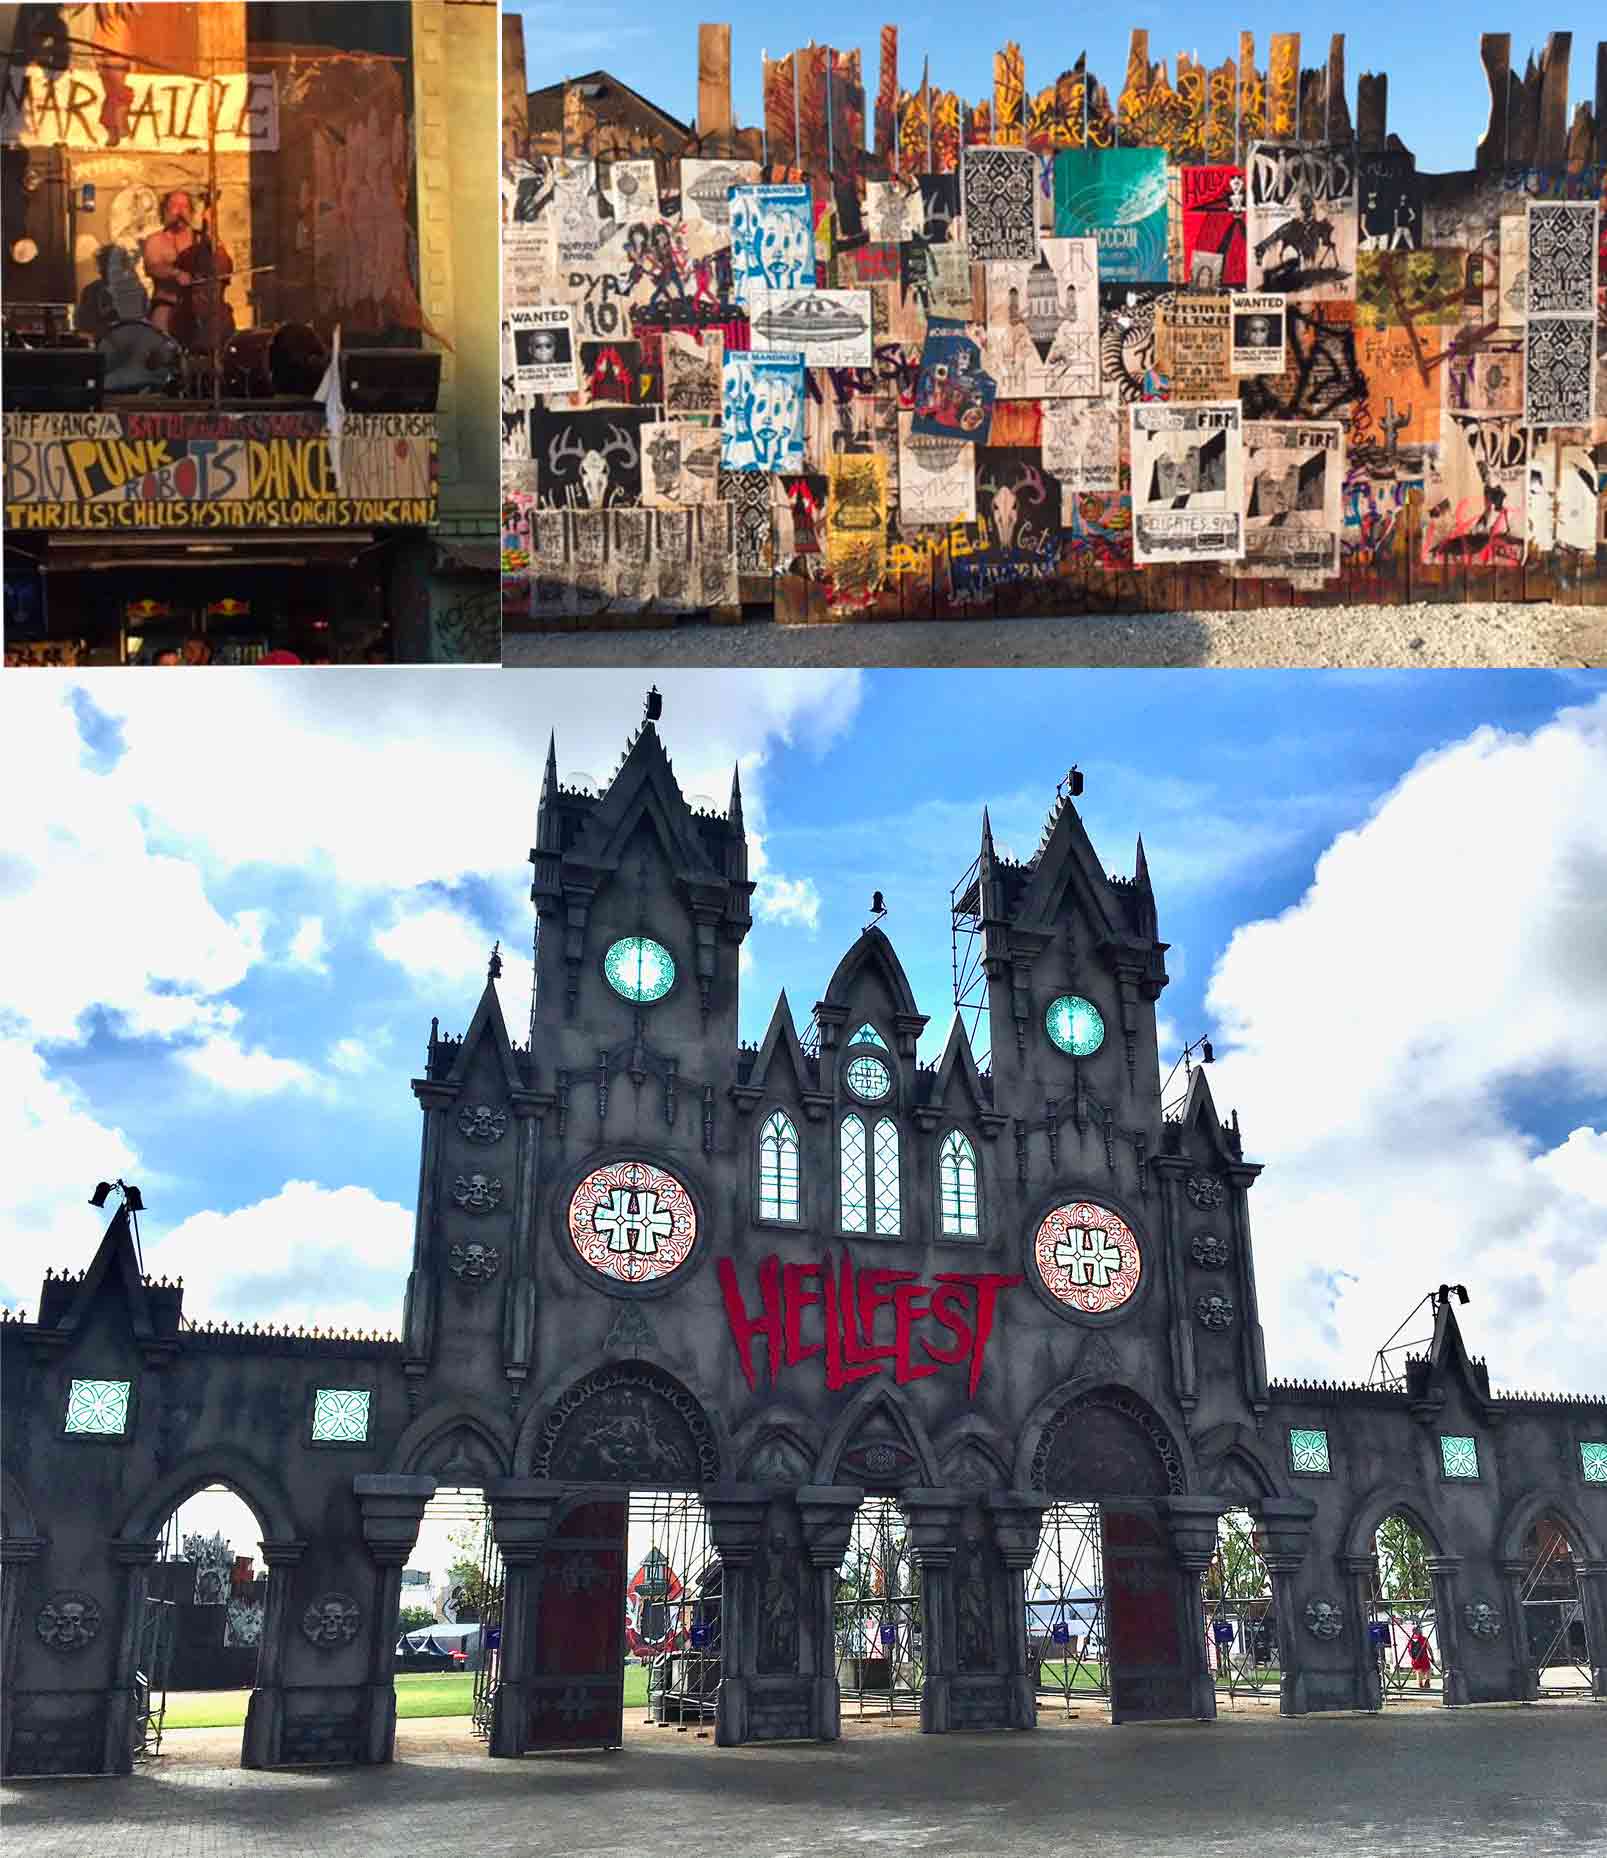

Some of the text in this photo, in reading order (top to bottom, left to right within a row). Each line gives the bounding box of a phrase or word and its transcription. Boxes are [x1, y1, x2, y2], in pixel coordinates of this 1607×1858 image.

[511, 310, 569, 323] WANTED
[1233, 297, 1283, 308] WANTED
[65, 438, 174, 499] PUNK
[248, 440, 337, 499] DANCE
[718, 1247, 1024, 1399] HELLFEST
